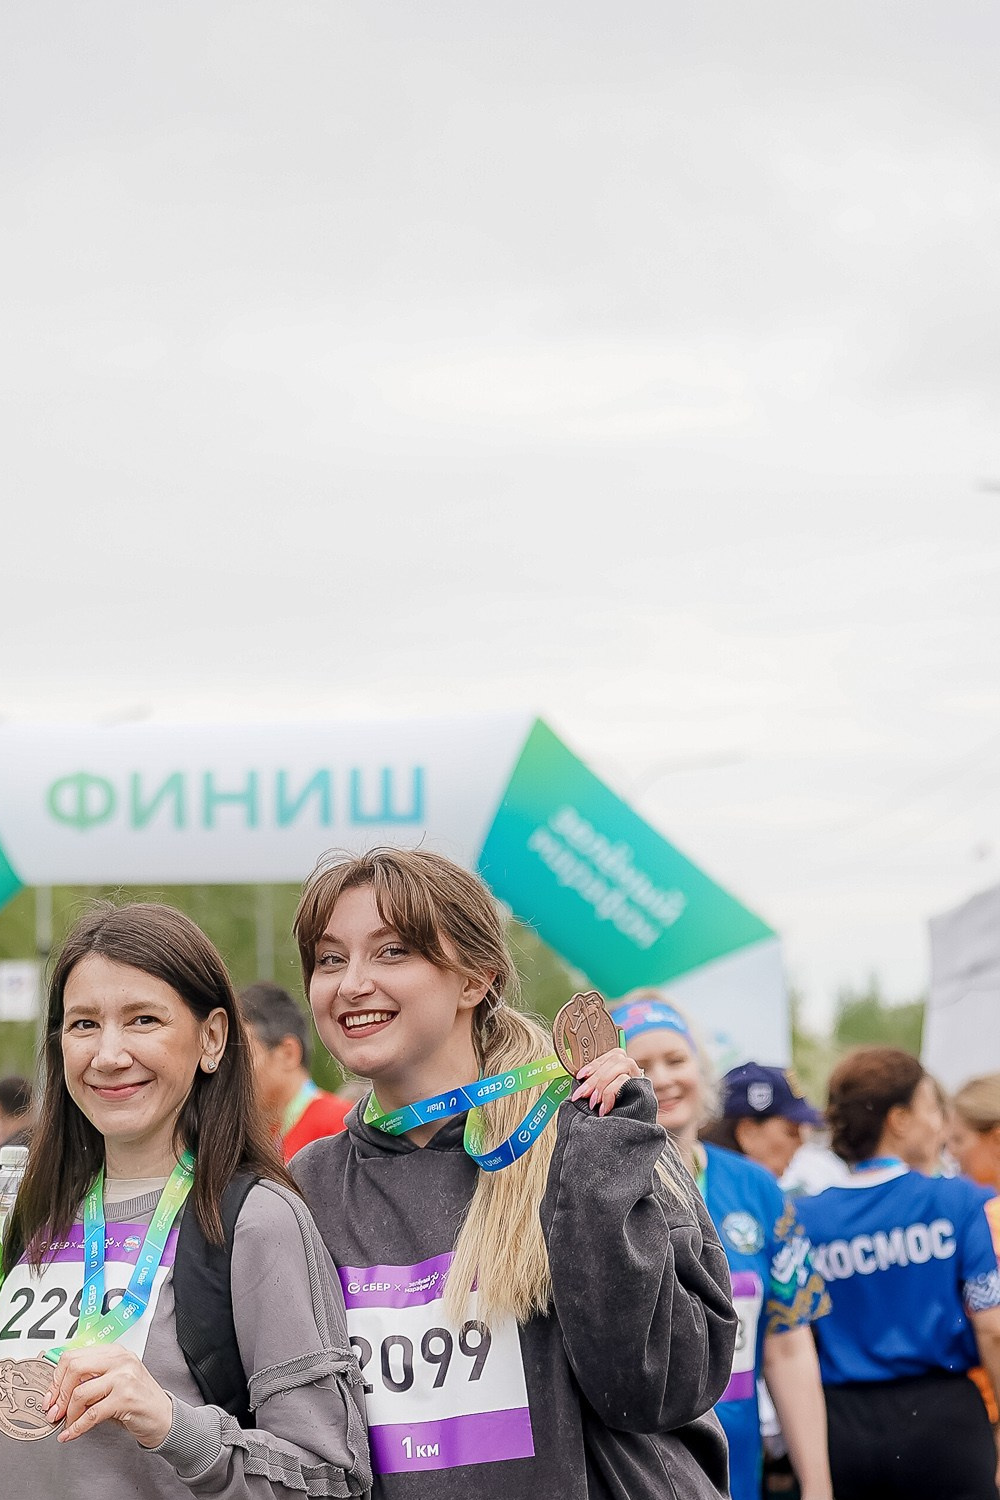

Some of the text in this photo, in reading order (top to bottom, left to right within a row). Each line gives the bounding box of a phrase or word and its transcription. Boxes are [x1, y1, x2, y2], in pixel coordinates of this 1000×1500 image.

[45, 766, 426, 831] ФИНИШ
[477, 1080, 502, 1098] СБЕР
[554, 1079, 571, 1096] 185
[426, 1101, 447, 1113] Utair
[528, 1103, 548, 1131] СБЕР
[812, 1217, 957, 1282] КОСМОС
[362, 1282, 391, 1292] СБЕР
[97, 1324, 115, 1339] 185
[349, 1319, 493, 1394] 2099
